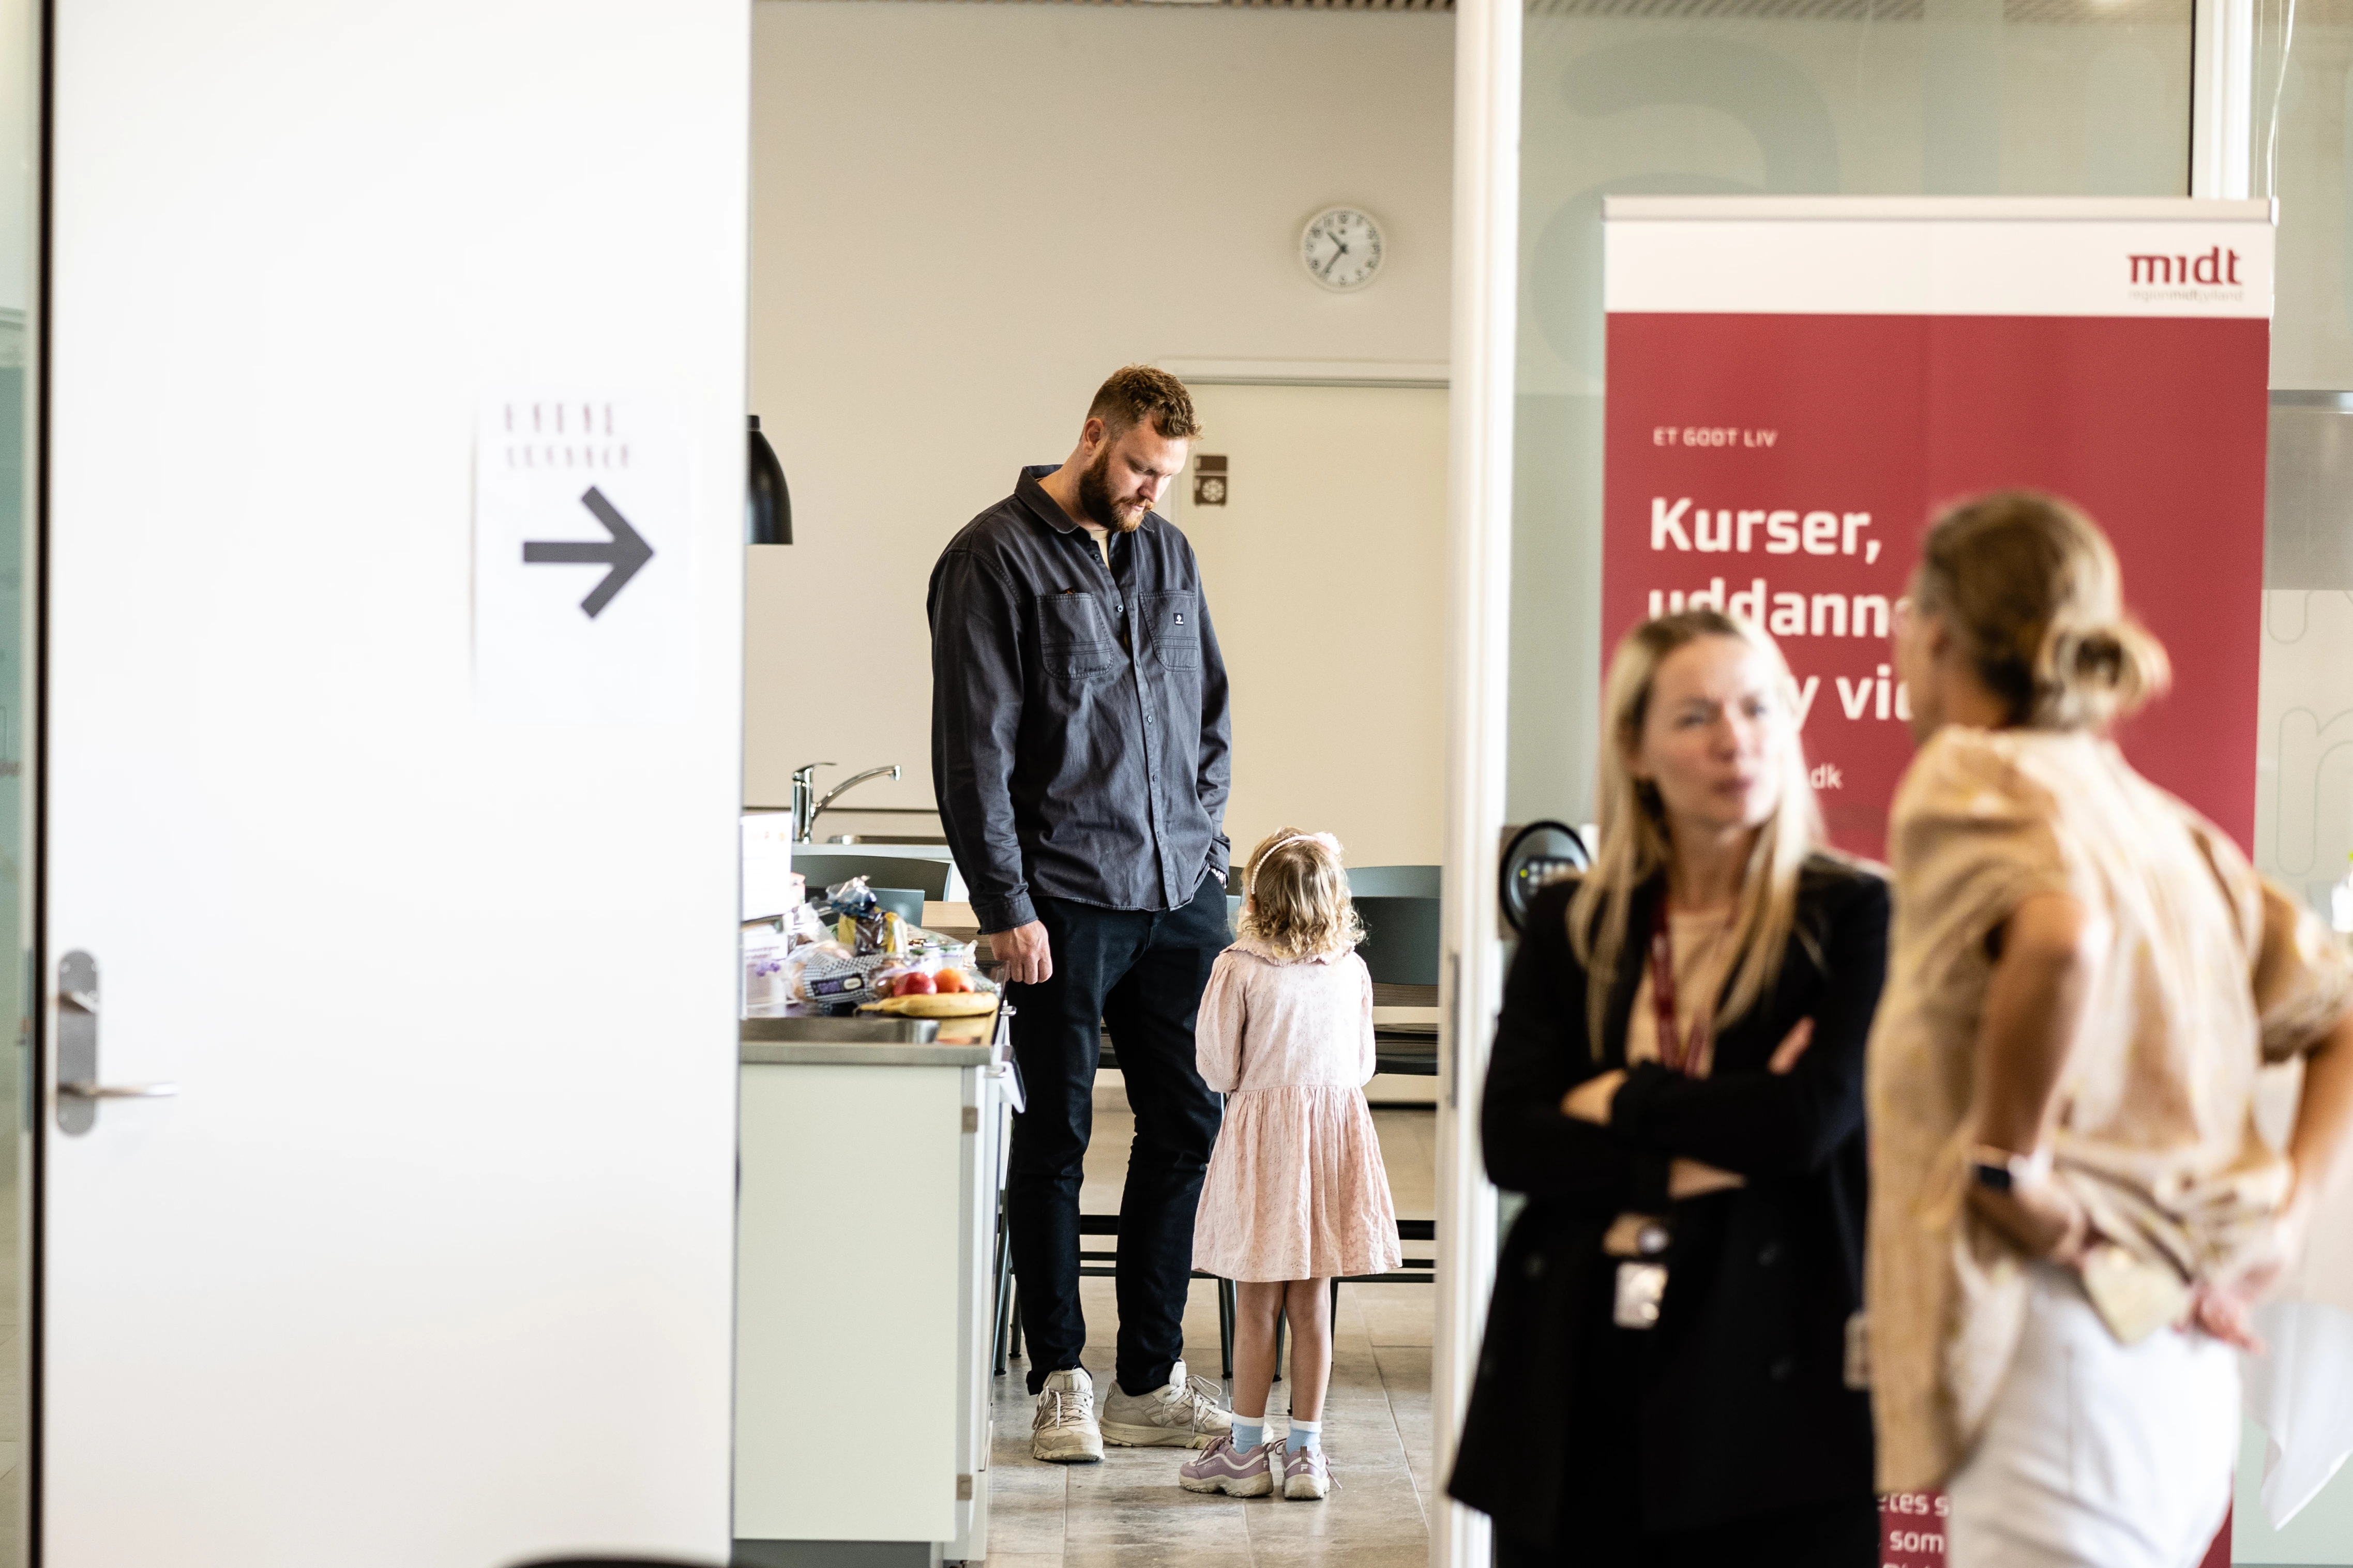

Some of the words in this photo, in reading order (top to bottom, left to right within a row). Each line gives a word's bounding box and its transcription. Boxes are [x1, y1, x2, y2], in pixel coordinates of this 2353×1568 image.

[2128, 245, 2242, 285] midt
[1654, 427, 1677, 446] ET
[1743, 429, 1778, 448] LIV
[1651, 497, 1881, 565] Kurser,
[1649, 577, 1891, 638] uddann
[1889, 1530, 1944, 1554] som
